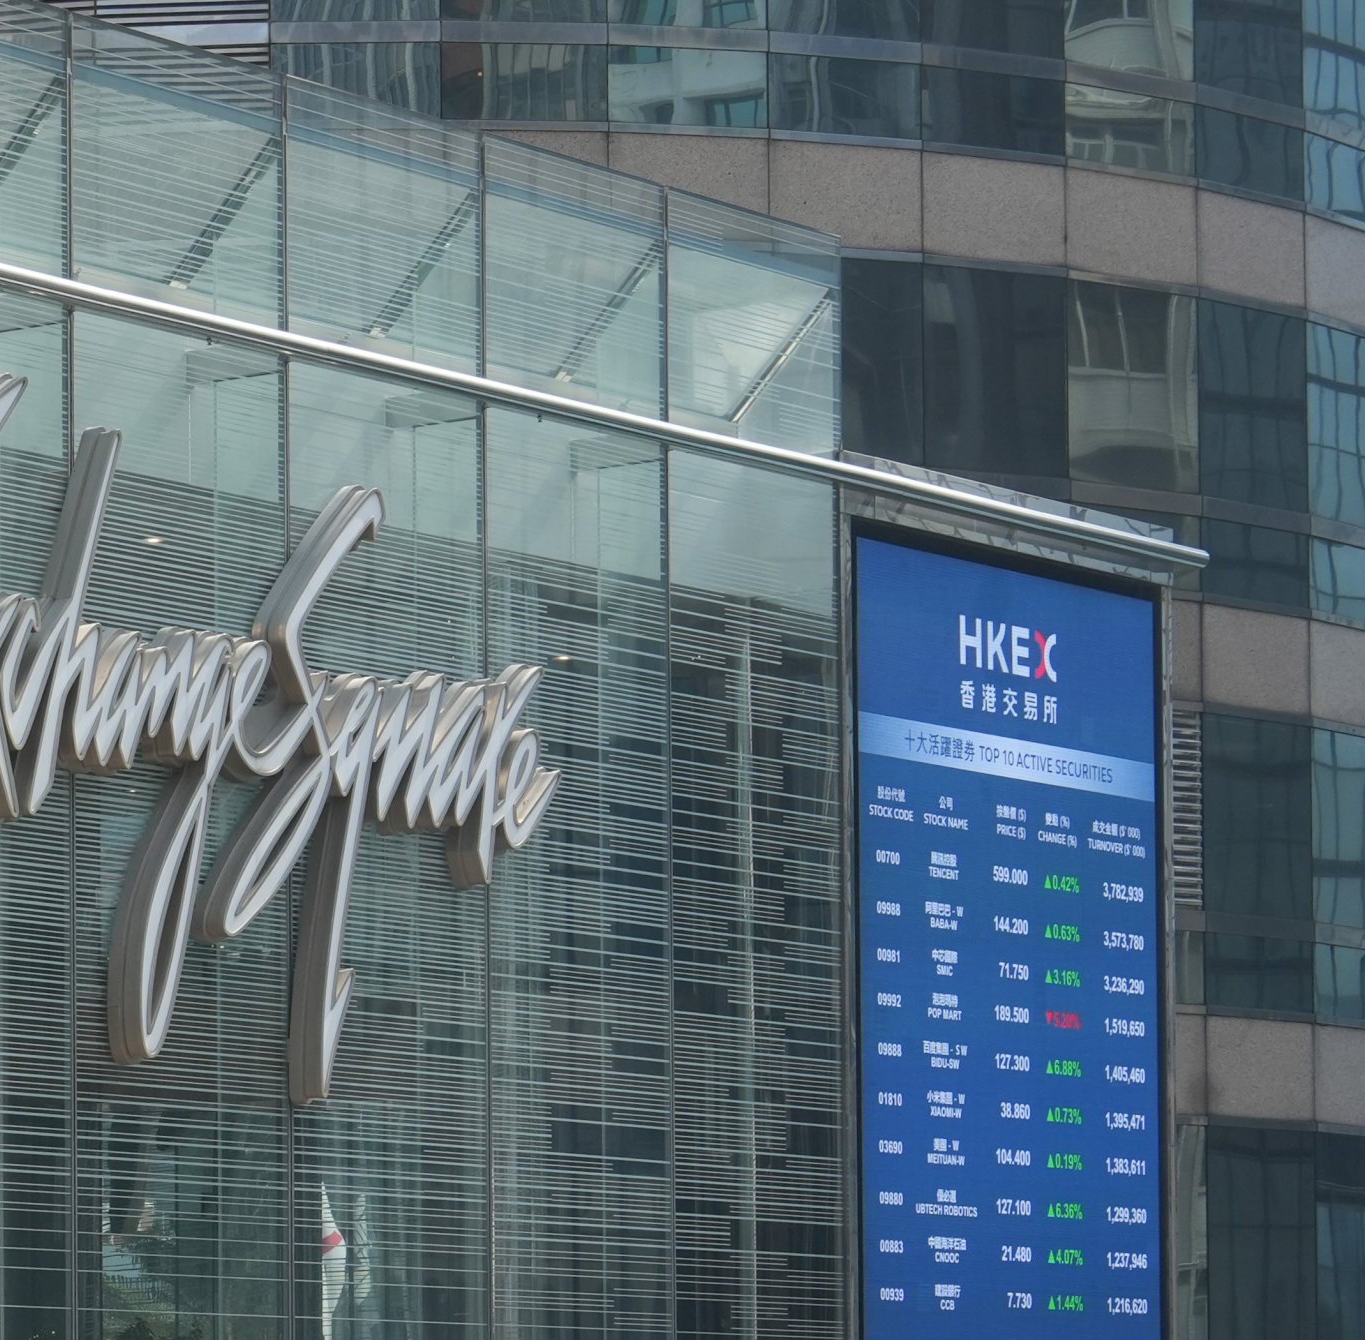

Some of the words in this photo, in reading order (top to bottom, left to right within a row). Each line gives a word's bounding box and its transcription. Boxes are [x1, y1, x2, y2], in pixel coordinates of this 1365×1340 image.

[960, 615, 1056, 682] HKEX
[961, 681, 1057, 724] 香港交易所
[905, 729, 975, 763] 十大活躍證券
[979, 746, 999, 762] TOP
[1003, 750, 1014, 766] 10
[1017, 753, 1052, 773] ACTIVE
[1056, 760, 1113, 784] SECURITIES
[192, 484, 561, 1105] Square
[869, 804, 892, 818] STOCK
[894, 809, 913, 821] CODE
[924, 813, 946, 826] STOCK
[948, 817, 968, 830] NAME
[876, 850, 900, 865] 00700
[929, 867, 959, 880] TENCENT
[993, 866, 1028, 885] 599.000
[1053, 875, 1079, 893] 0.42%
[1103, 882, 1143, 902] 3,782,939
[877, 901, 900, 916] 09988
[931, 918, 957, 930] BABA-W
[994, 916, 1028, 935] 144.200
[1051, 925, 1079, 942] 0.63%
[1104, 931, 1144, 951] 3,573,780
[877, 949, 900, 962] 00981
[937, 965, 953, 976] SMIC
[999, 962, 1029, 980] 71.750
[1053, 970, 1080, 987] 3.16%
[1104, 976, 1144, 995] 3,236,290
[878, 1043, 902, 1056] 09888
[931, 1057, 959, 1069] BIDU-SW
[995, 1054, 1029, 1071] 127.300
[1054, 1060, 1081, 1077] 6.88%
[1105, 1065, 1145, 1084] 1,405,460
[880, 1192, 903, 1205] 09880
[916, 1204, 942, 1214] UBTECH
[944, 1205, 977, 1217] ROBOTICS
[997, 1199, 1031, 1215] 127.100
[1056, 1203, 1082, 1219] 6.36%
[1107, 1207, 1146, 1224] 1,299,360
[880, 1240, 903, 1253] 00883
[935, 1253, 959, 1263] CNOOC
[1002, 1247, 1031, 1262] 21.480
[1056, 1251, 1083, 1265] 4.07%
[1107, 1252, 1147, 1270] 1,237,946
